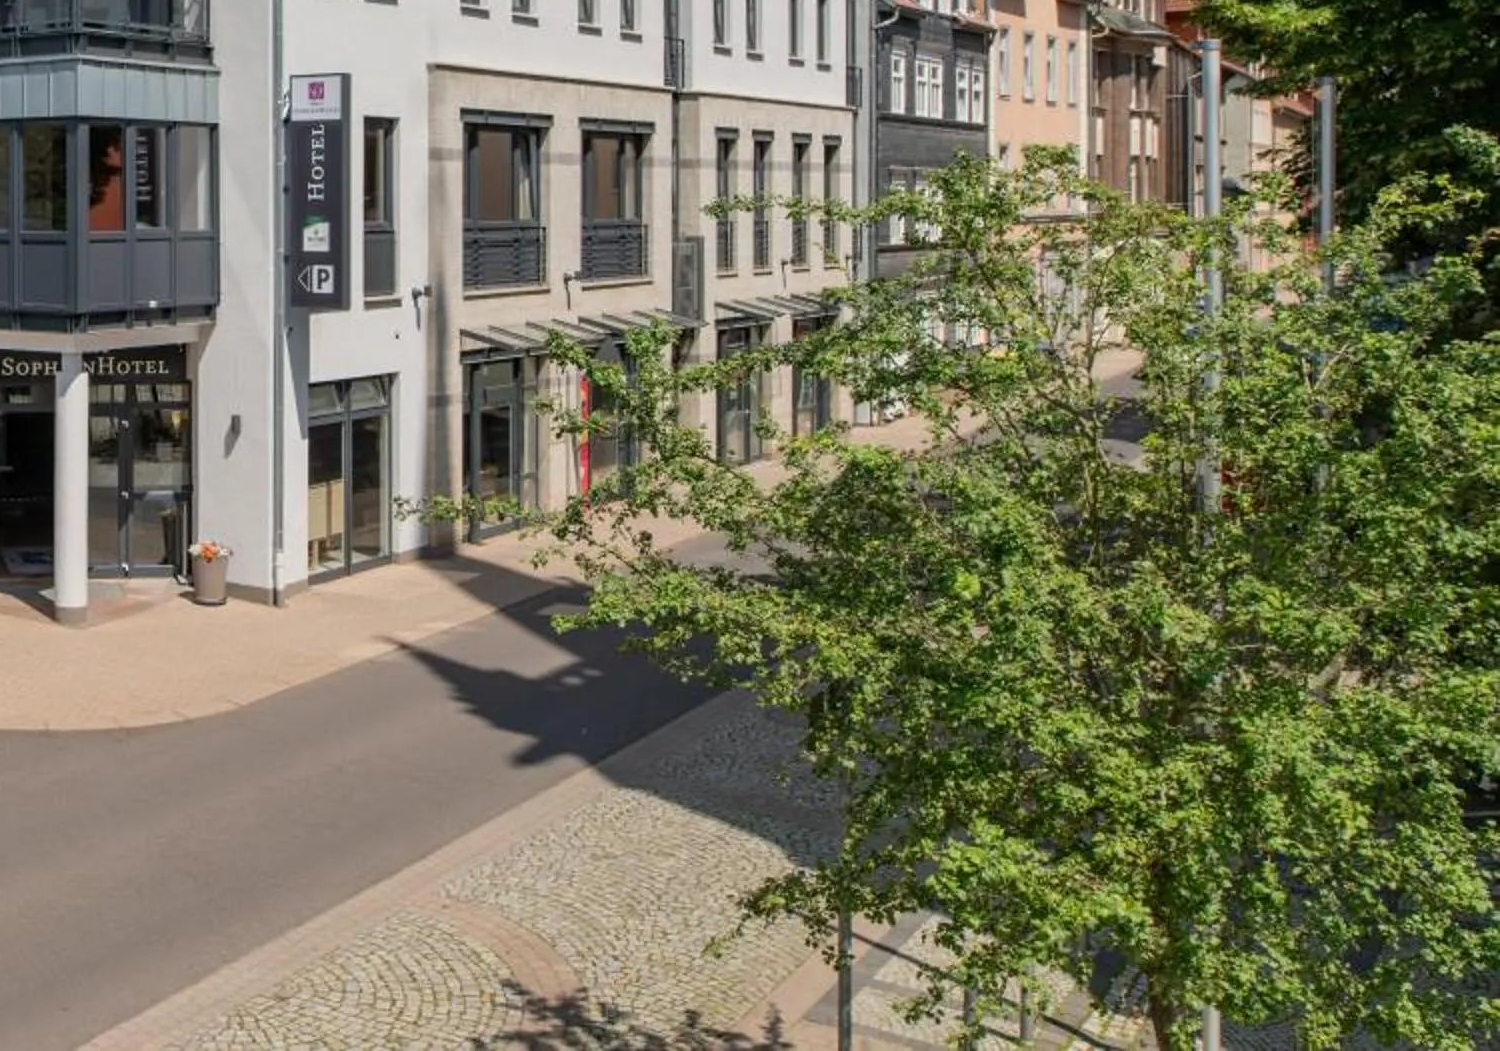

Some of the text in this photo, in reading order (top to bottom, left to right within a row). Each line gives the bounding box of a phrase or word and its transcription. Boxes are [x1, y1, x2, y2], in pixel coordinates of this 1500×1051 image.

[307, 123, 325, 202] HOTEL
[317, 268, 330, 290] P
[1, 356, 169, 377] SOPHNHOTEL
